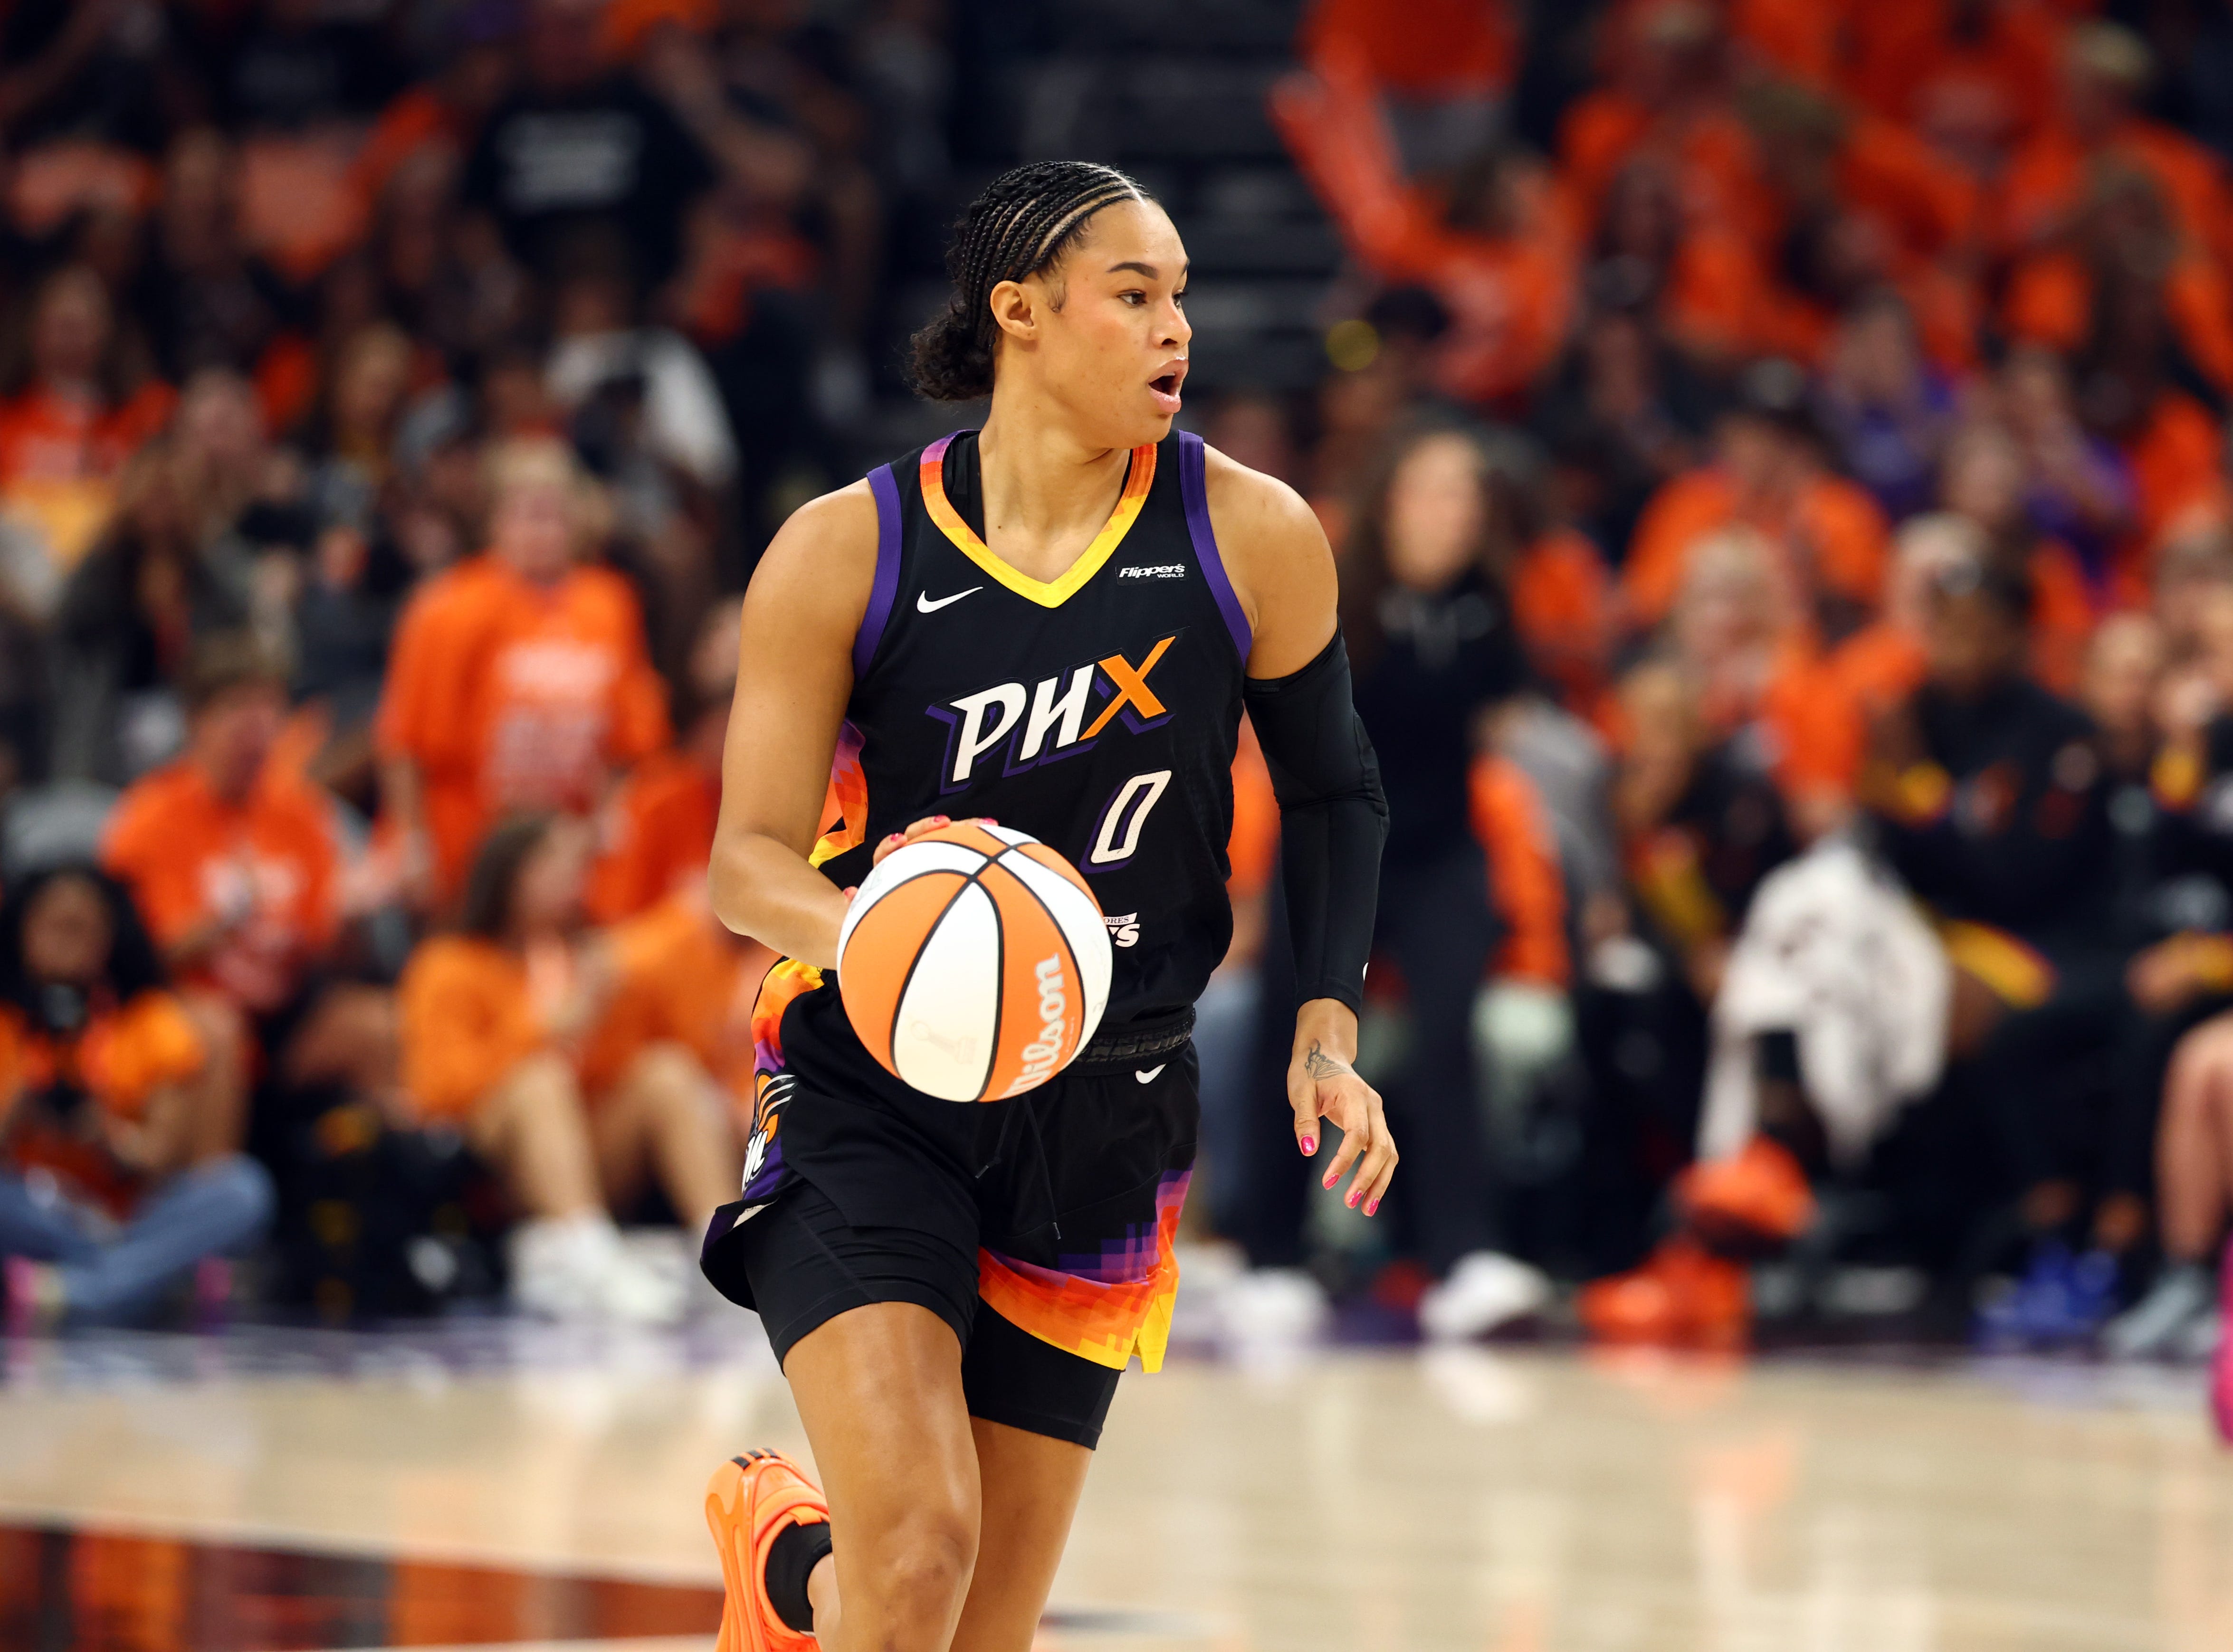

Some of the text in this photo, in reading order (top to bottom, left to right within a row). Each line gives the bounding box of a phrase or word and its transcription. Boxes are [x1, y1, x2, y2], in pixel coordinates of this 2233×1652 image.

[1119, 564, 1185, 578] Flipper's
[948, 636, 1176, 783] PHX
[1090, 769, 1172, 864] 0
